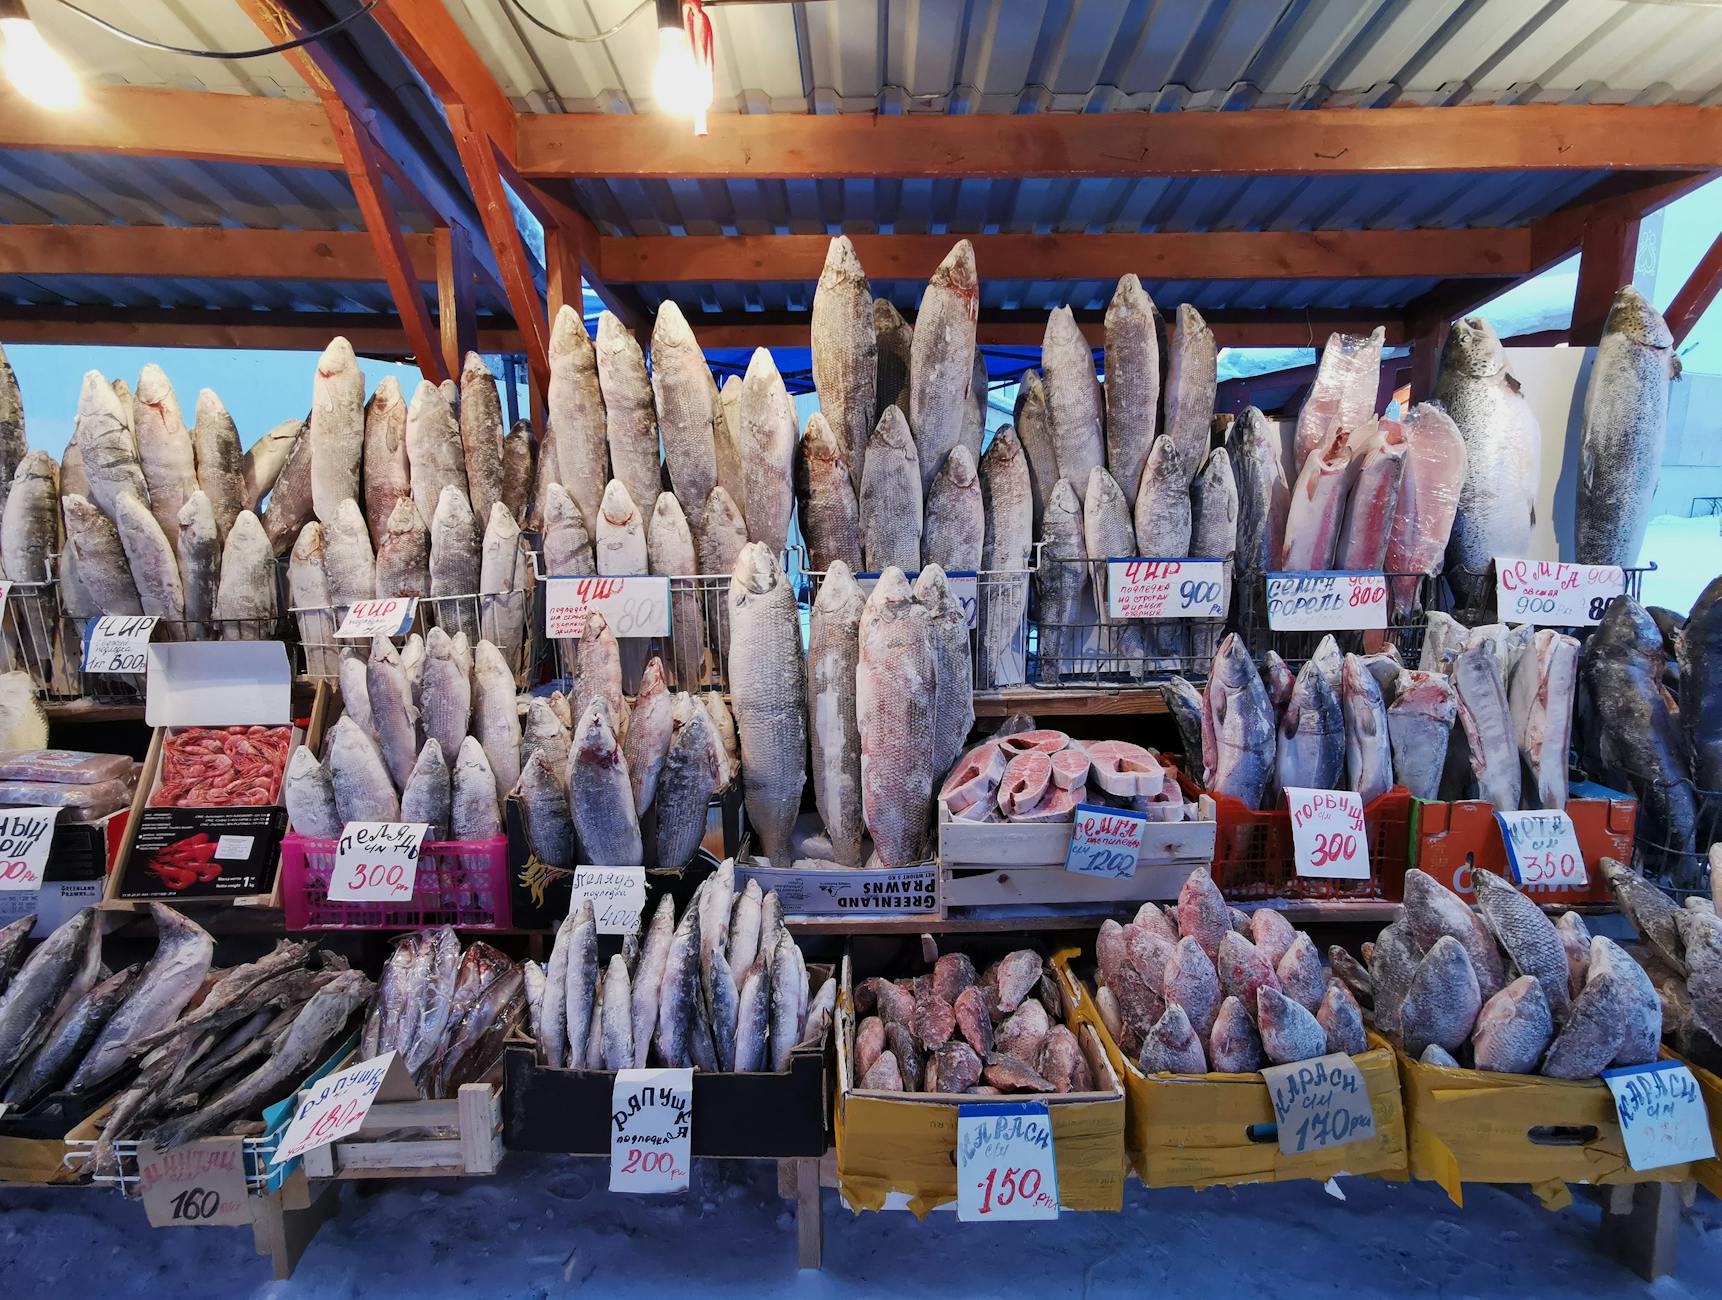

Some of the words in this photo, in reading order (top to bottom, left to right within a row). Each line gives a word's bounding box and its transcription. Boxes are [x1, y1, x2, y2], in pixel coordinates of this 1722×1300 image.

[1125, 562, 1181, 584] ЧИР
[1502, 561, 1580, 591] СЕМГА
[1180, 580, 1220, 609] 900
[1268, 594, 1344, 617] ФОРЕЛЬ
[1348, 586, 1385, 607] 800
[1516, 596, 1555, 614] 900
[352, 602, 397, 618] ЧИР
[99, 617, 155, 637] ЧИР
[1295, 794, 1363, 832] ГОРБУША
[1080, 849, 1134, 871] 1200
[1310, 833, 1357, 867] 300
[348, 863, 403, 890] 300
[1523, 851, 1575, 882] 350
[863, 879, 935, 893] PRAWNS
[838, 895, 936, 908] GREENLAND
[300, 1068, 387, 1120] РЯПУШКА
[303, 1099, 357, 1142] 180
[613, 1087, 692, 1140] РЯПУШКА
[1296, 1108, 1350, 1151] 170
[621, 1149, 674, 1173] 200
[170, 1187, 220, 1220] 160
[984, 1168, 1041, 1214] 150
